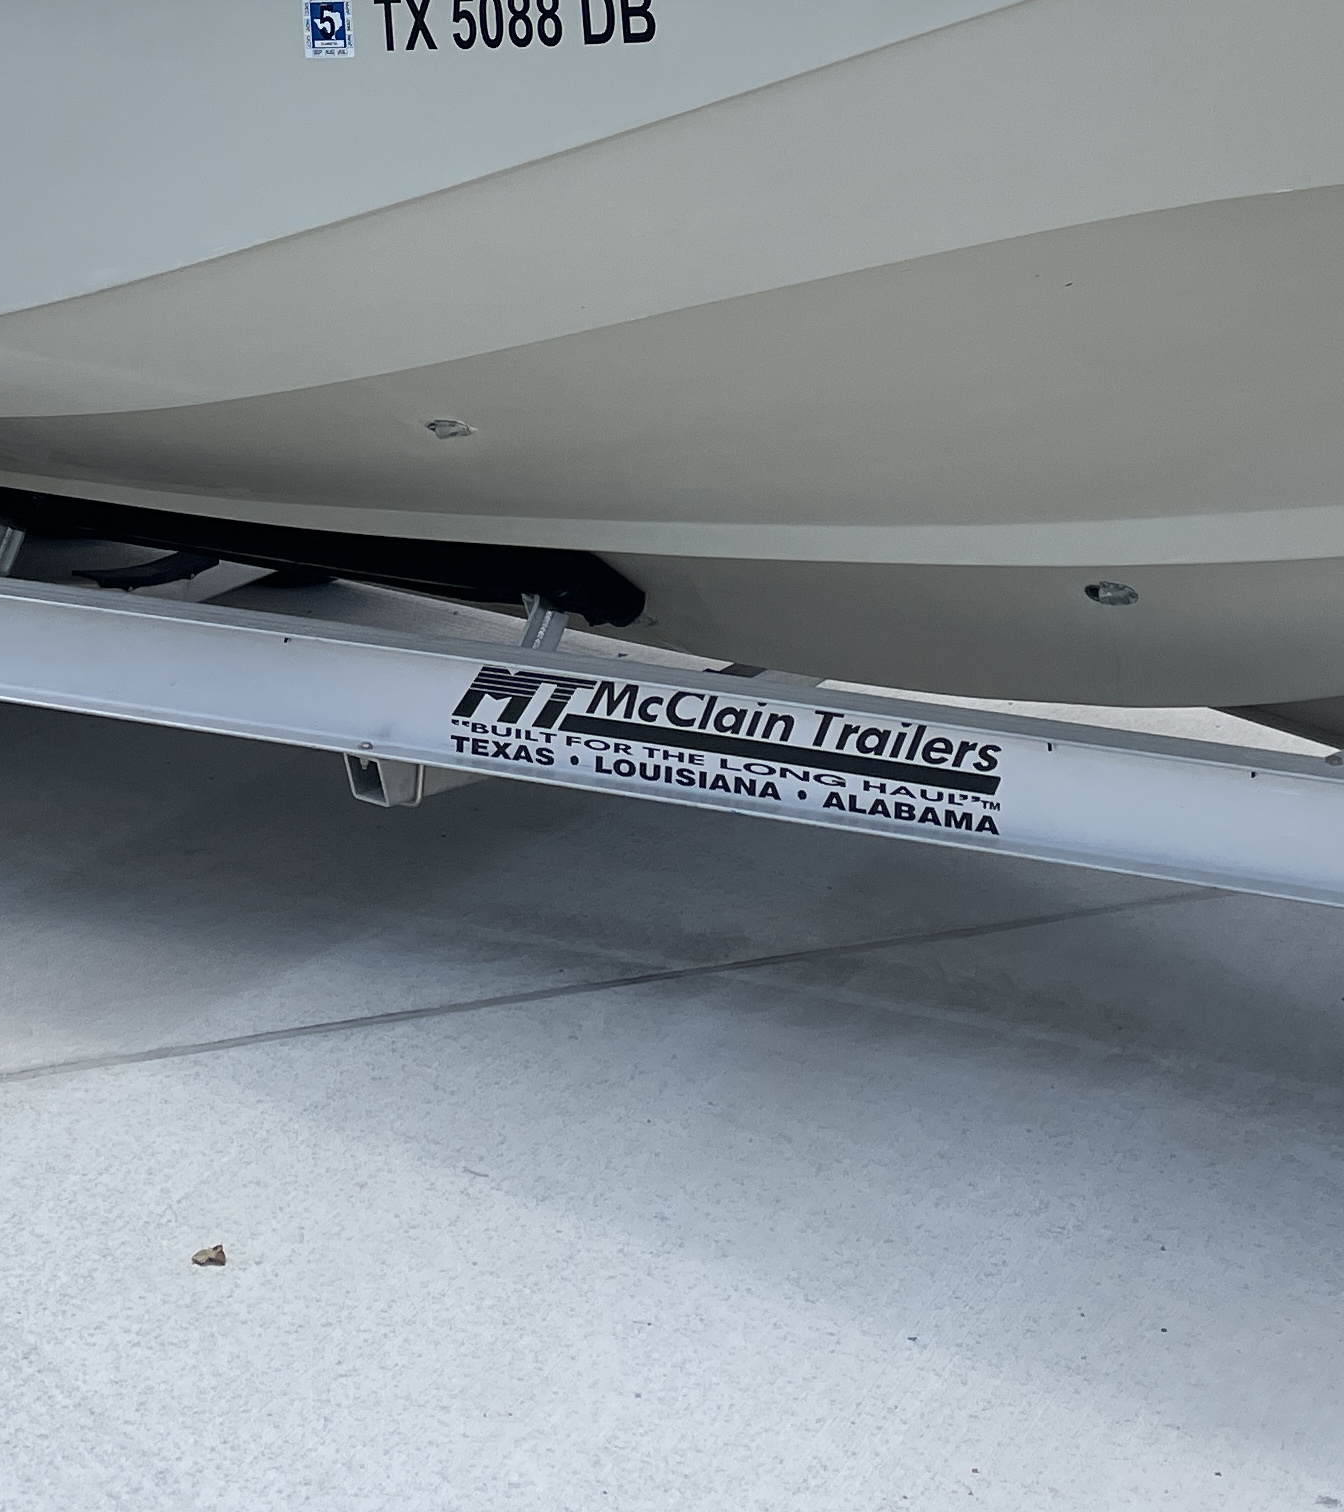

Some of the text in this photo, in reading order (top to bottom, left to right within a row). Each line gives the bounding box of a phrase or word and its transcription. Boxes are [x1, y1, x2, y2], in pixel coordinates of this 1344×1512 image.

[319, 4, 336, 39] 5
[451, 664, 1003, 772] MT McClain Trailers
[451, 735, 1000, 836] TEXAS LOUISIANA ALABAMA
[565, 736, 633, 756] FOR
[642, 746, 706, 766] THE
[719, 757, 847, 788] LONG
